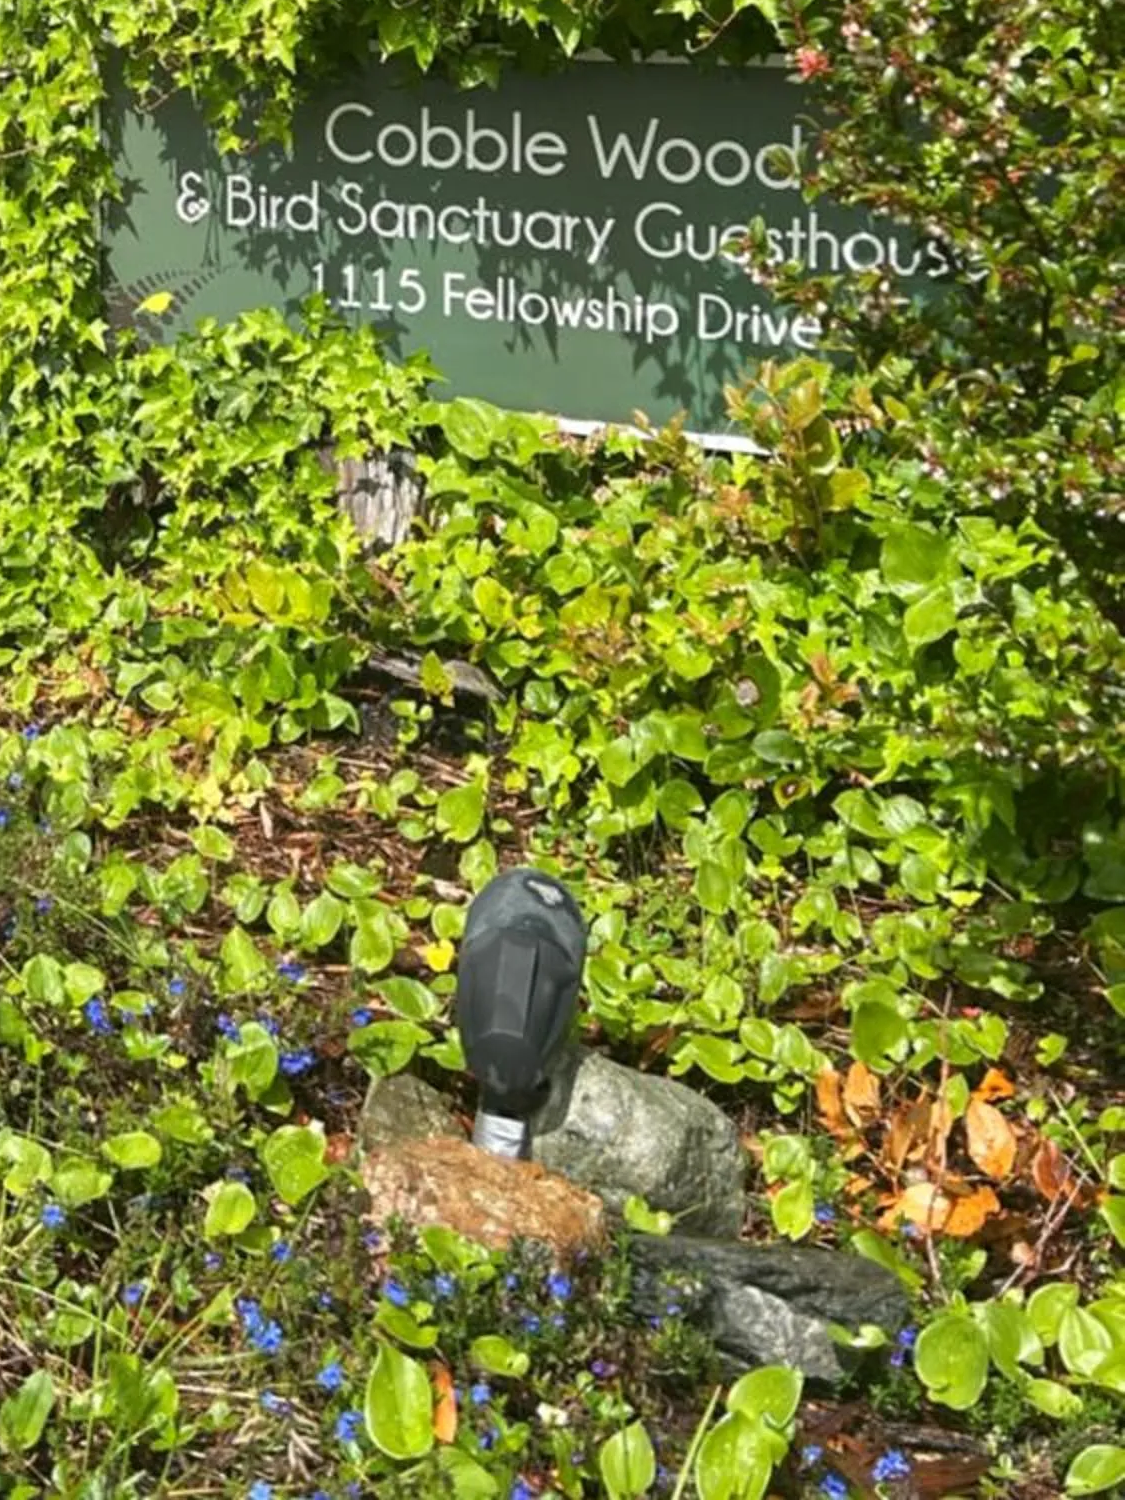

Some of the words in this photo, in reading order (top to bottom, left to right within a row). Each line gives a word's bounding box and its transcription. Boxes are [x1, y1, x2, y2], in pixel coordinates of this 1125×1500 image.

[325, 102, 568, 176] Cobble
[176, 171, 211, 223] &
[226, 174, 320, 232] Bird
[337, 182, 616, 265] Sanctuary
[312, 262, 427, 313] 1115
[443, 272, 679, 344] Fellowship
[698, 293, 823, 350] Drive
